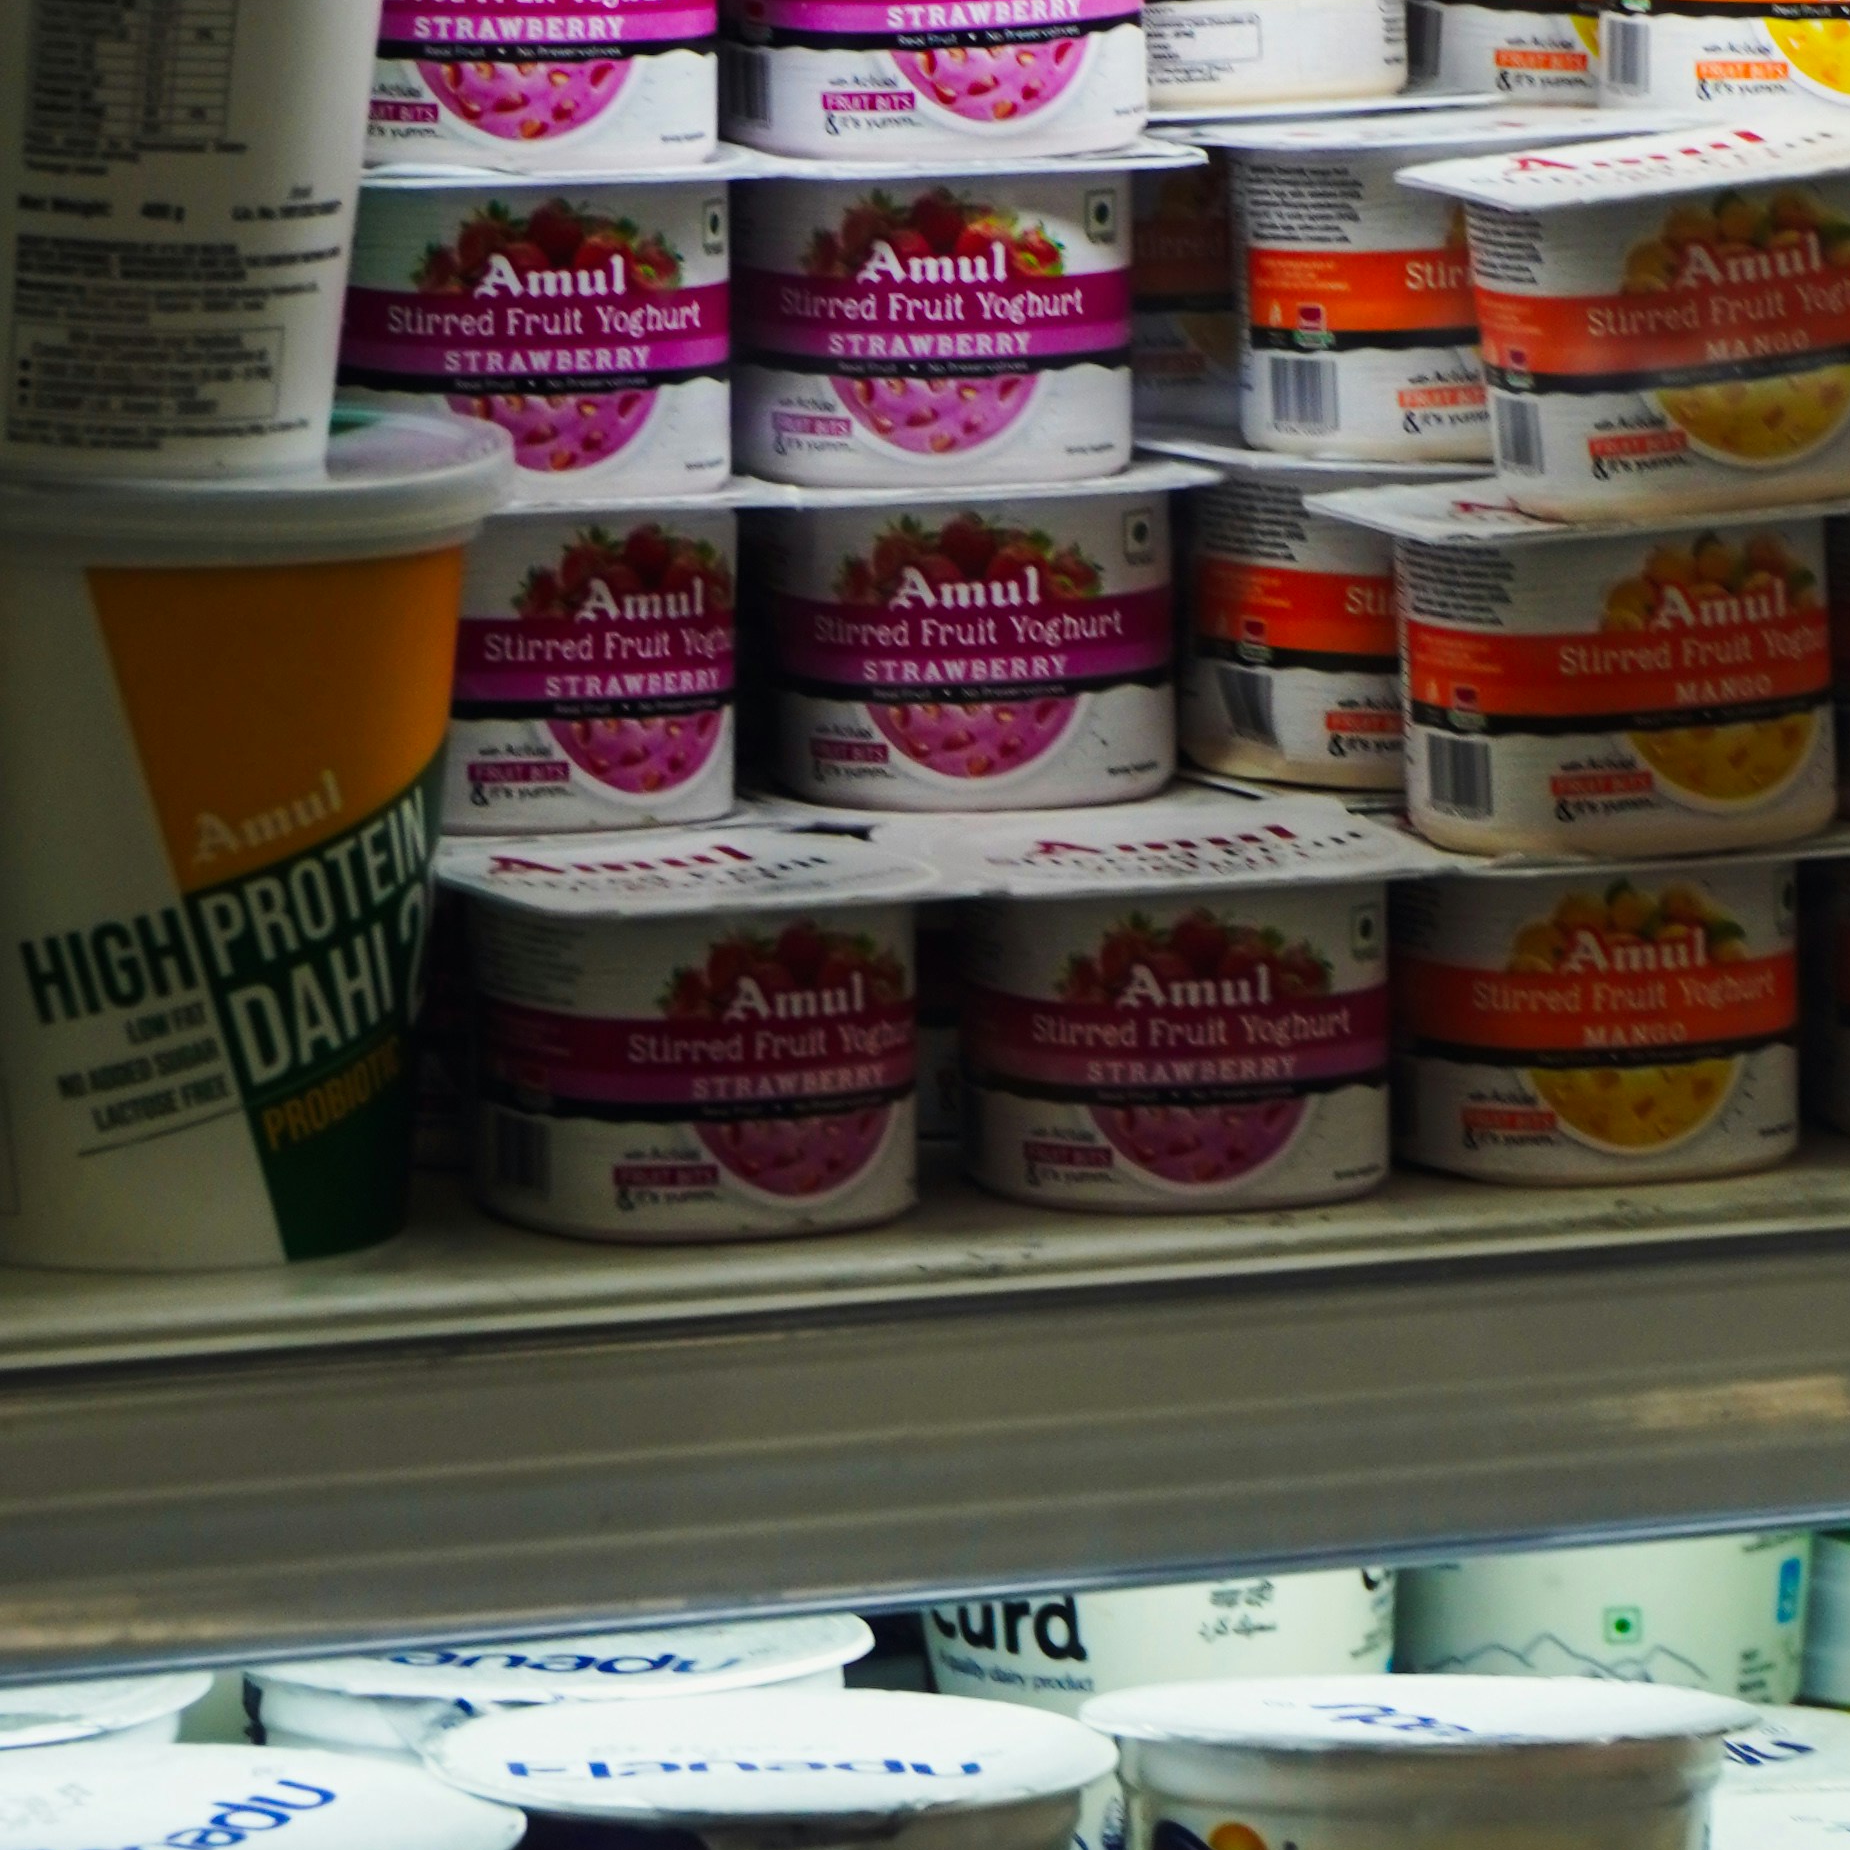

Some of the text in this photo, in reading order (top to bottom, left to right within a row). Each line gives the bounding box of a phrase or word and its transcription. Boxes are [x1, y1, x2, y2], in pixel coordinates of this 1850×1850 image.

[413, 14, 625, 41] STRAWBERRY
[475, 253, 628, 299] Amul
[856, 240, 1008, 285] Amul
[1677, 231, 1823, 291] Amul
[388, 300, 701, 339] Stirred Fruit Yoghurt
[780, 286, 1084, 326] Stirred Fruit Yoghurt
[1587, 284, 1787, 336] Stirred Fruit
[443, 346, 652, 373] STRAWBERRY
[827, 330, 1033, 358] STRAWBERRY
[1705, 329, 1810, 361] MANGO
[574, 578, 705, 626] Amul
[890, 566, 1042, 611] Amul
[1650, 580, 1789, 633] Amul
[483, 630, 672, 665] Stirred Fruit
[812, 608, 1125, 647] Stirred Fruit Yoghurt
[862, 653, 1069, 684] STRAWBERRY
[1558, 634, 1754, 678] Stirred Fruit
[544, 667, 721, 699] STRAWBERRY
[1673, 673, 1774, 706] MANGO
[192, 767, 346, 865] Amul
[198, 784, 430, 980] PROTEIN
[19, 905, 198, 1026] HIGH
[1561, 927, 1710, 971] Amul
[226, 922, 395, 1088] DAHI
[724, 971, 866, 1022] Amul
[1117, 963, 1273, 1009] Amul
[1472, 980, 1581, 1011] Stirred
[626, 1027, 829, 1064] Stirred Fruit
[1031, 1007, 1352, 1048] Stirred Fruit Yoghurt
[1581, 1023, 1687, 1047] MANGO
[1086, 1054, 1300, 1083] STRAWBERRY
